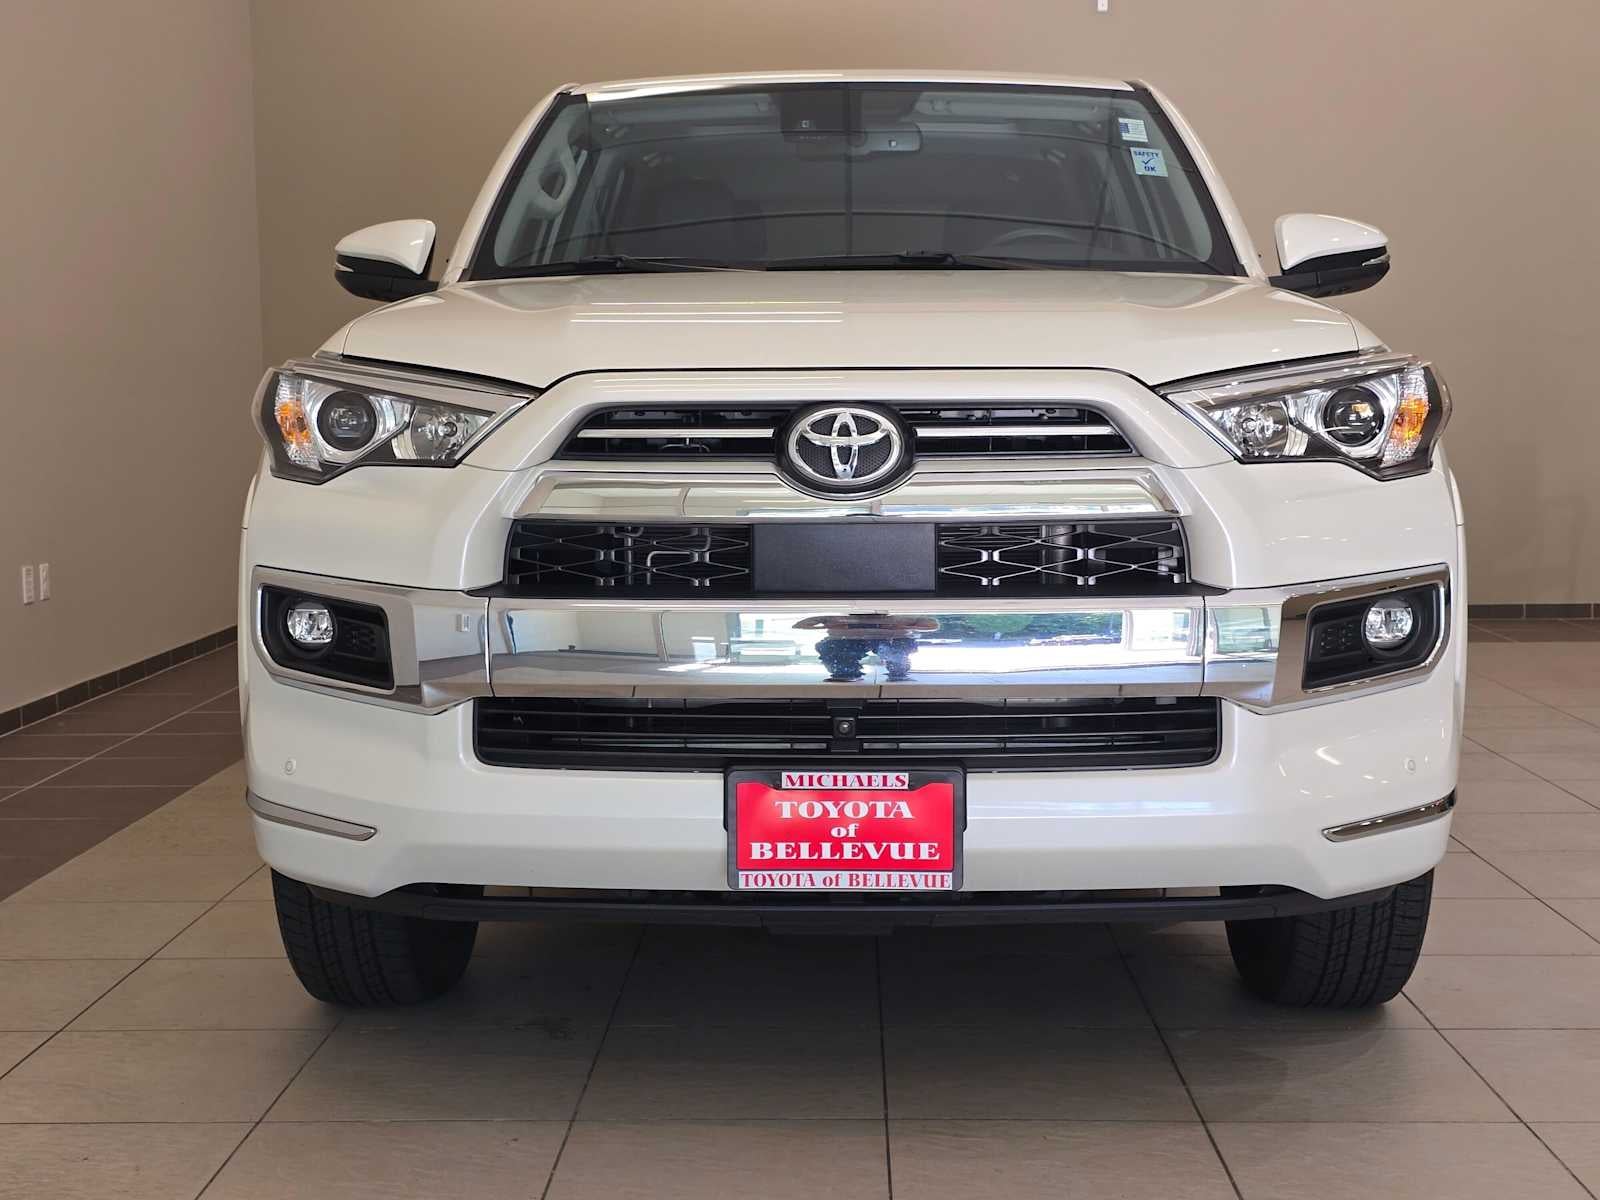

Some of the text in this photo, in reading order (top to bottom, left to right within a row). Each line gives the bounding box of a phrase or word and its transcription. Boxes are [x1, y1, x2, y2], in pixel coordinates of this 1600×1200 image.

[785, 774, 906, 787] MICHAELS
[775, 800, 914, 819] TOYOTA
[831, 823, 859, 838] of
[750, 842, 940, 860] BELLEVUE
[741, 873, 951, 889] TOYOTA of BELLEVUE
